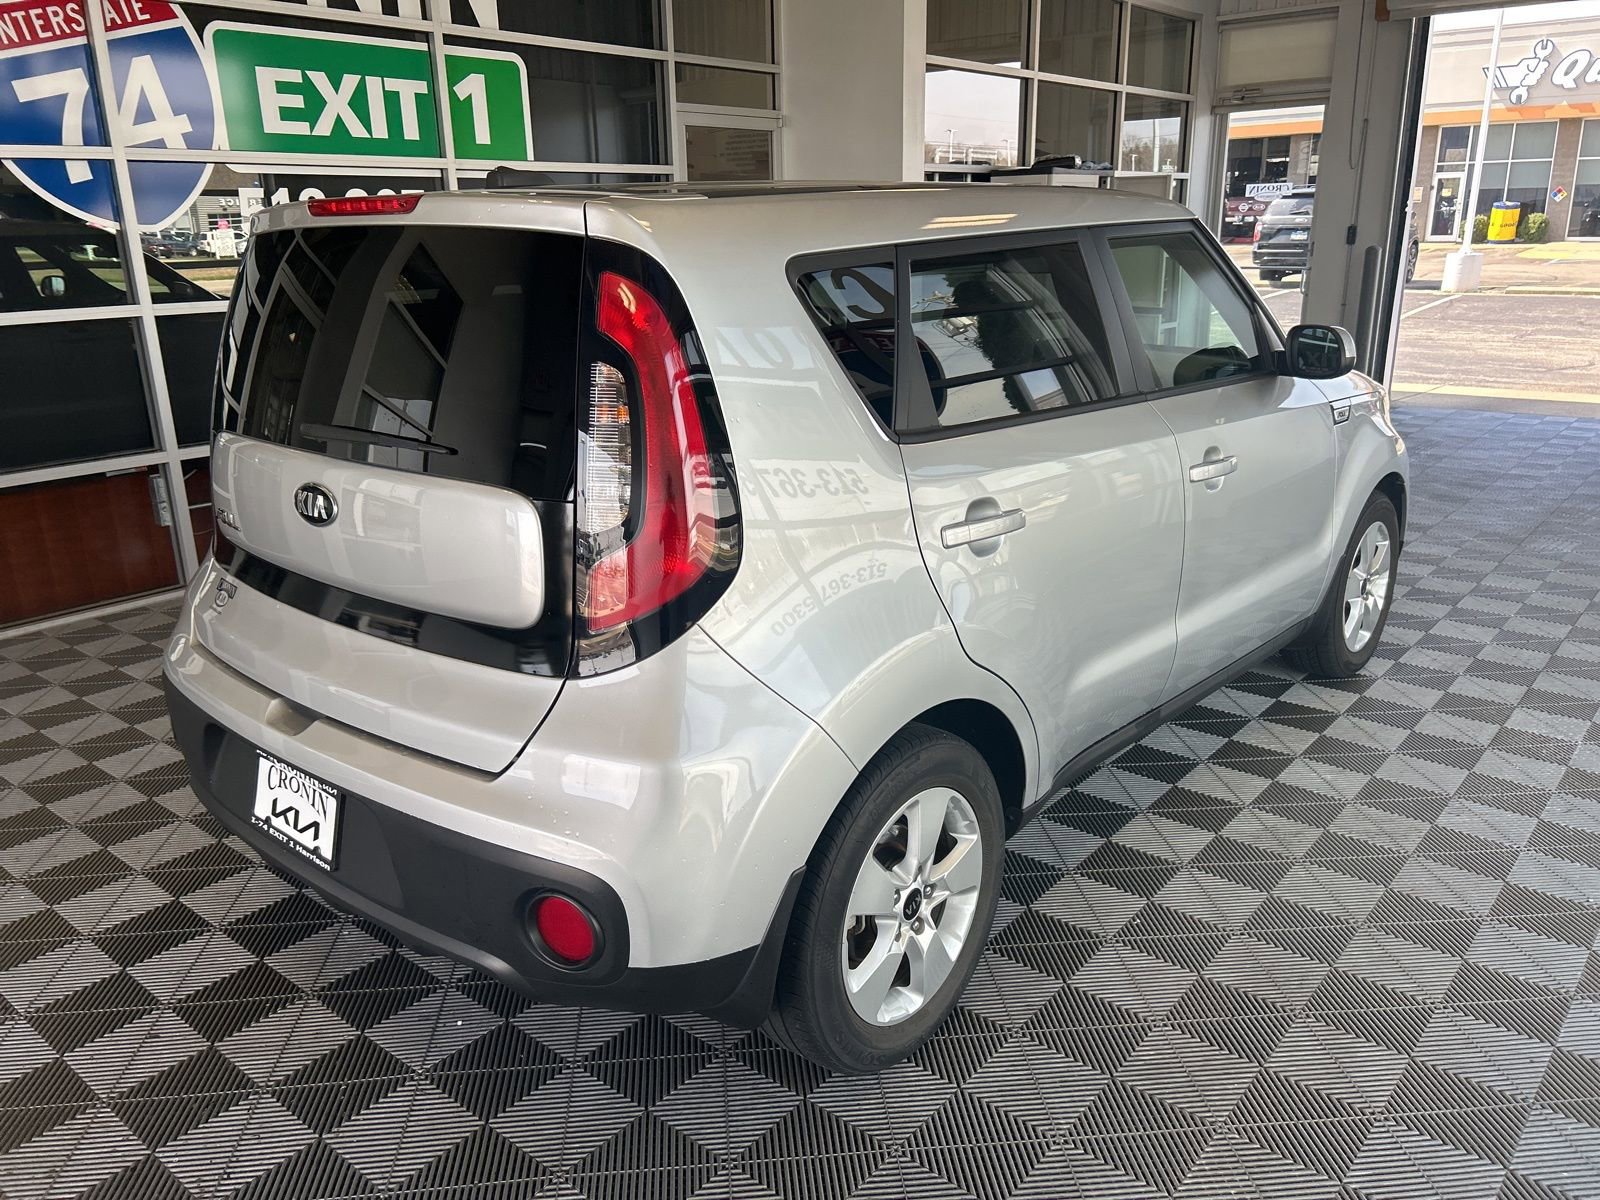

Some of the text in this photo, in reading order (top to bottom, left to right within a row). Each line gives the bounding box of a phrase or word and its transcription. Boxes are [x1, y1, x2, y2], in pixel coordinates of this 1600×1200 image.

[0, 0, 150, 44] NTERSATE
[11, 55, 193, 184] 74
[255, 66, 491, 145] EXIT 1
[297, 488, 329, 520] KIA
[268, 764, 329, 823] CRONIN
[251, 816, 331, 872] I-74 EXIT 1 Harrison
[905, 893, 921, 915] KIA
